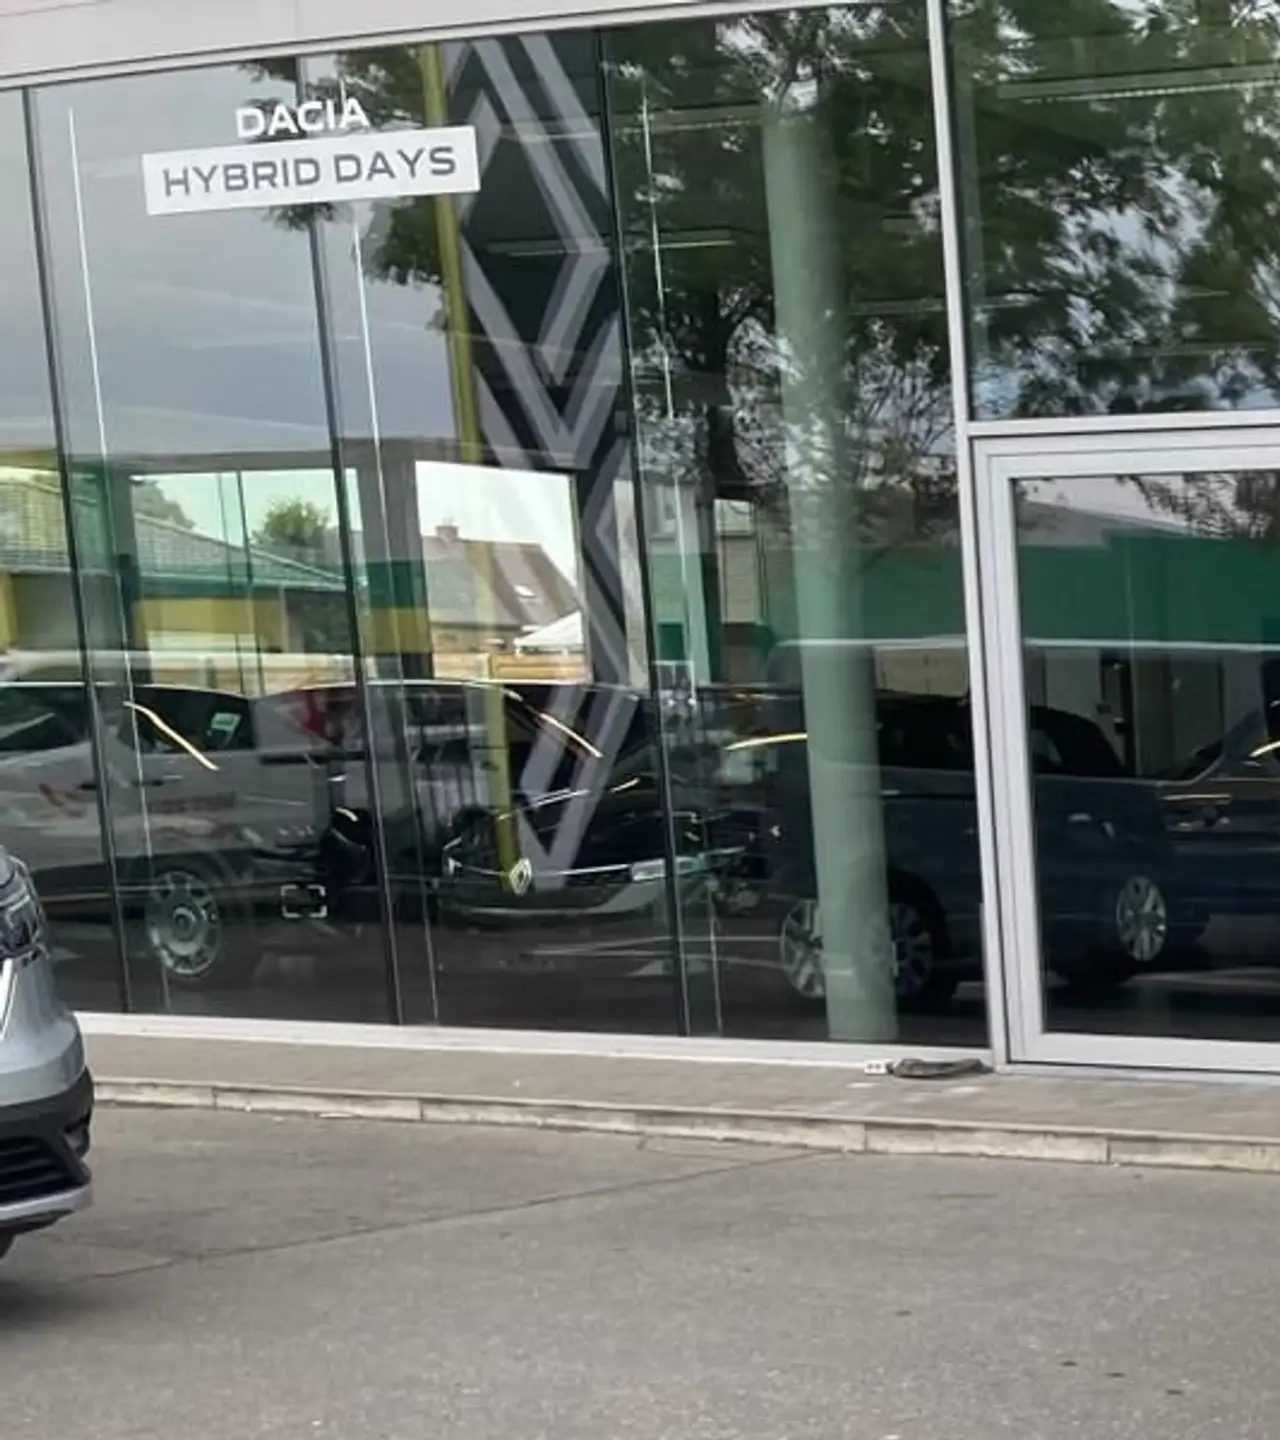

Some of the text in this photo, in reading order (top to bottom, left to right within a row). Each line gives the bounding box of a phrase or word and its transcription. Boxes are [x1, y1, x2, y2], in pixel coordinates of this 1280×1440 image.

[234, 97, 370, 138] DACIA
[162, 146, 457, 197] HYBRID DAYS
